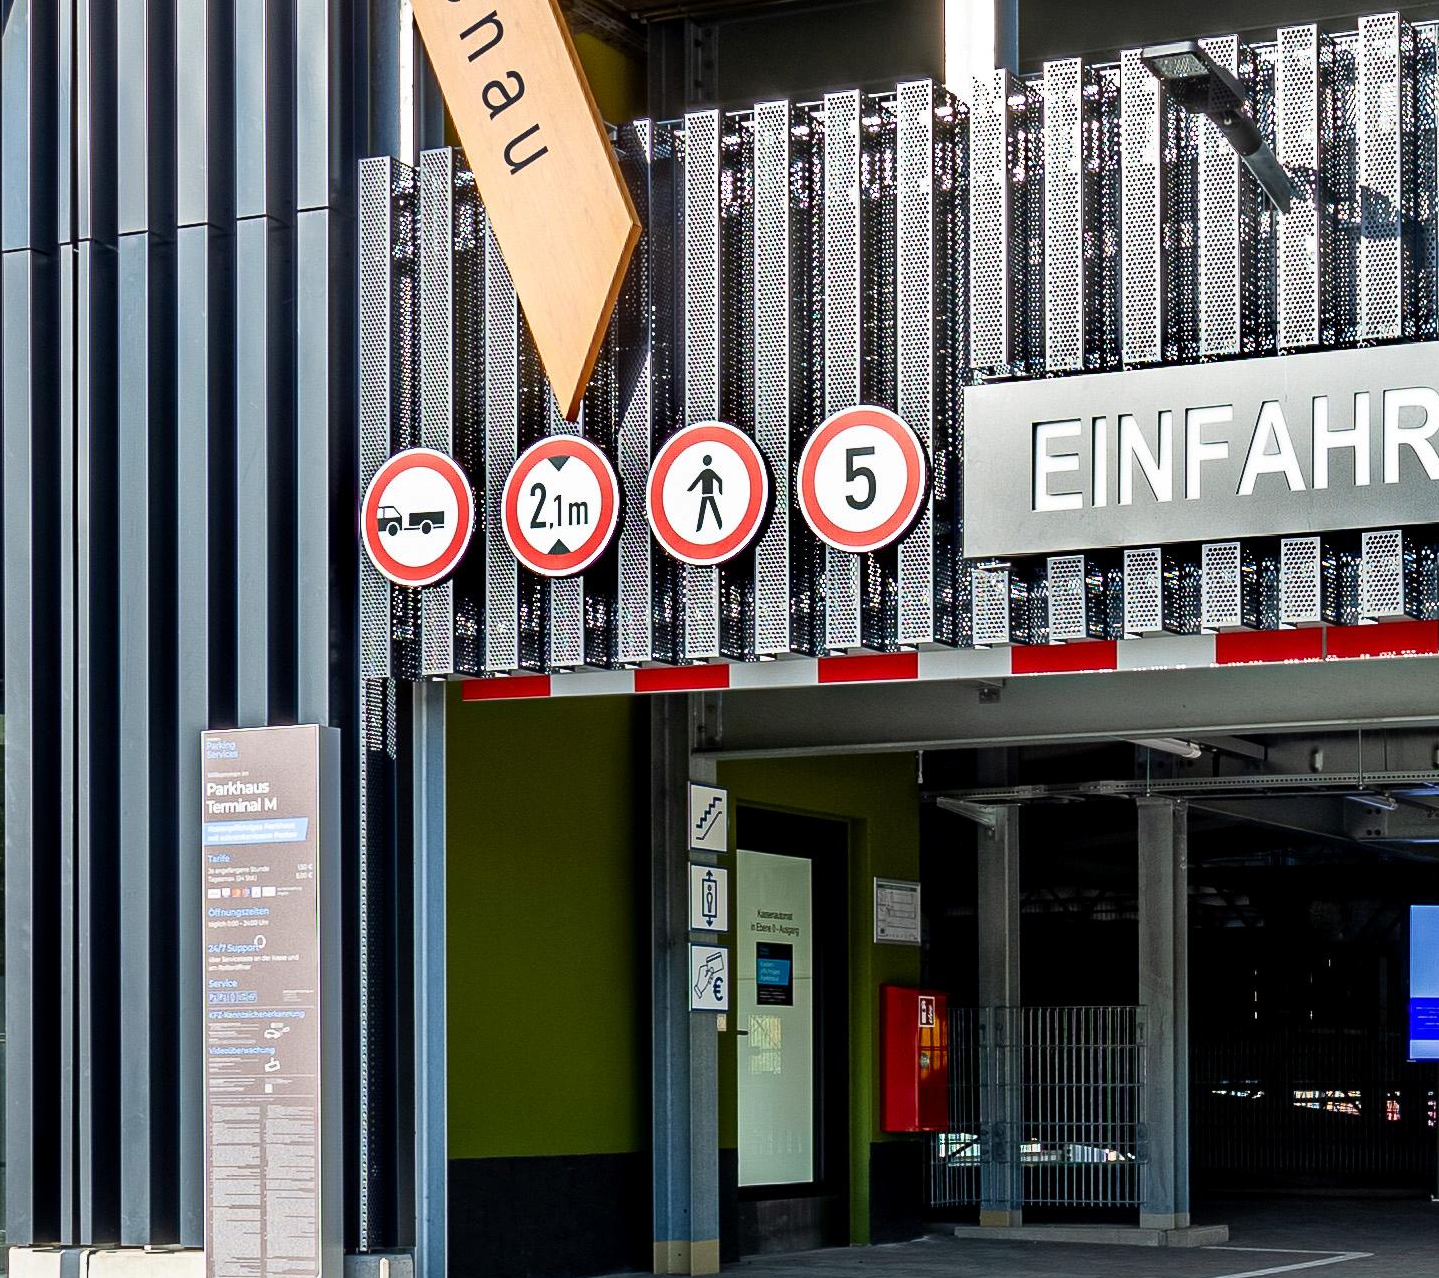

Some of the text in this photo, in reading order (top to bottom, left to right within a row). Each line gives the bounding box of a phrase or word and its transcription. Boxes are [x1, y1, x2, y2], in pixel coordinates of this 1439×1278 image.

[845, 446, 877, 510] 5
[206, 781, 270, 796] Parkhaus
[206, 797, 277, 814] Terminal M
[208, 854, 230, 863] Tarife
[208, 907, 269, 917] Öffnungszeiten
[756, 923, 771, 932] Ebene
[227, 944, 260, 953] Support
[209, 979, 238, 988] Service
